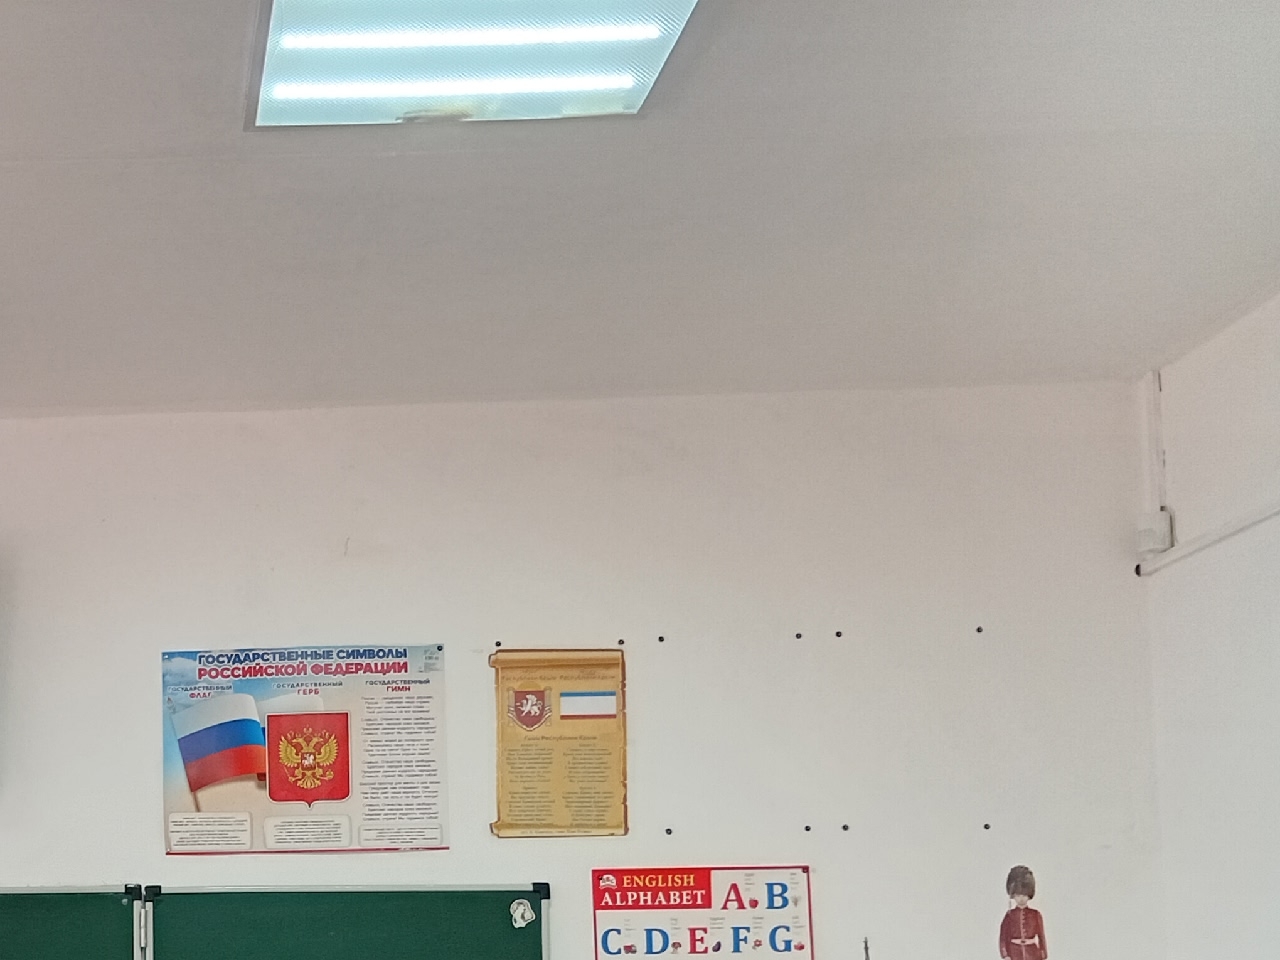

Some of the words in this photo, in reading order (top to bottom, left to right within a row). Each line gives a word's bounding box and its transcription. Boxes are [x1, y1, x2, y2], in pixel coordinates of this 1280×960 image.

[198, 650, 334, 665] ГОСУДАРСТВЕННЫЕ
[336, 648, 408, 660] СИМВОЛЫ
[197, 661, 308, 680] РОССИЙСКОЙ
[310, 661, 408, 676] ФЕДЕРАЦИИ
[622, 874, 695, 888] ENGLISH
[599, 890, 706, 906] ALPHABET
[721, 882, 747, 910] A
[764, 882, 789, 910] B
[601, 928, 622, 955] C
[644, 928, 670, 955] D
[687, 927, 709, 954] E
[730, 926, 751, 953] F
[768, 925, 793, 953] G
